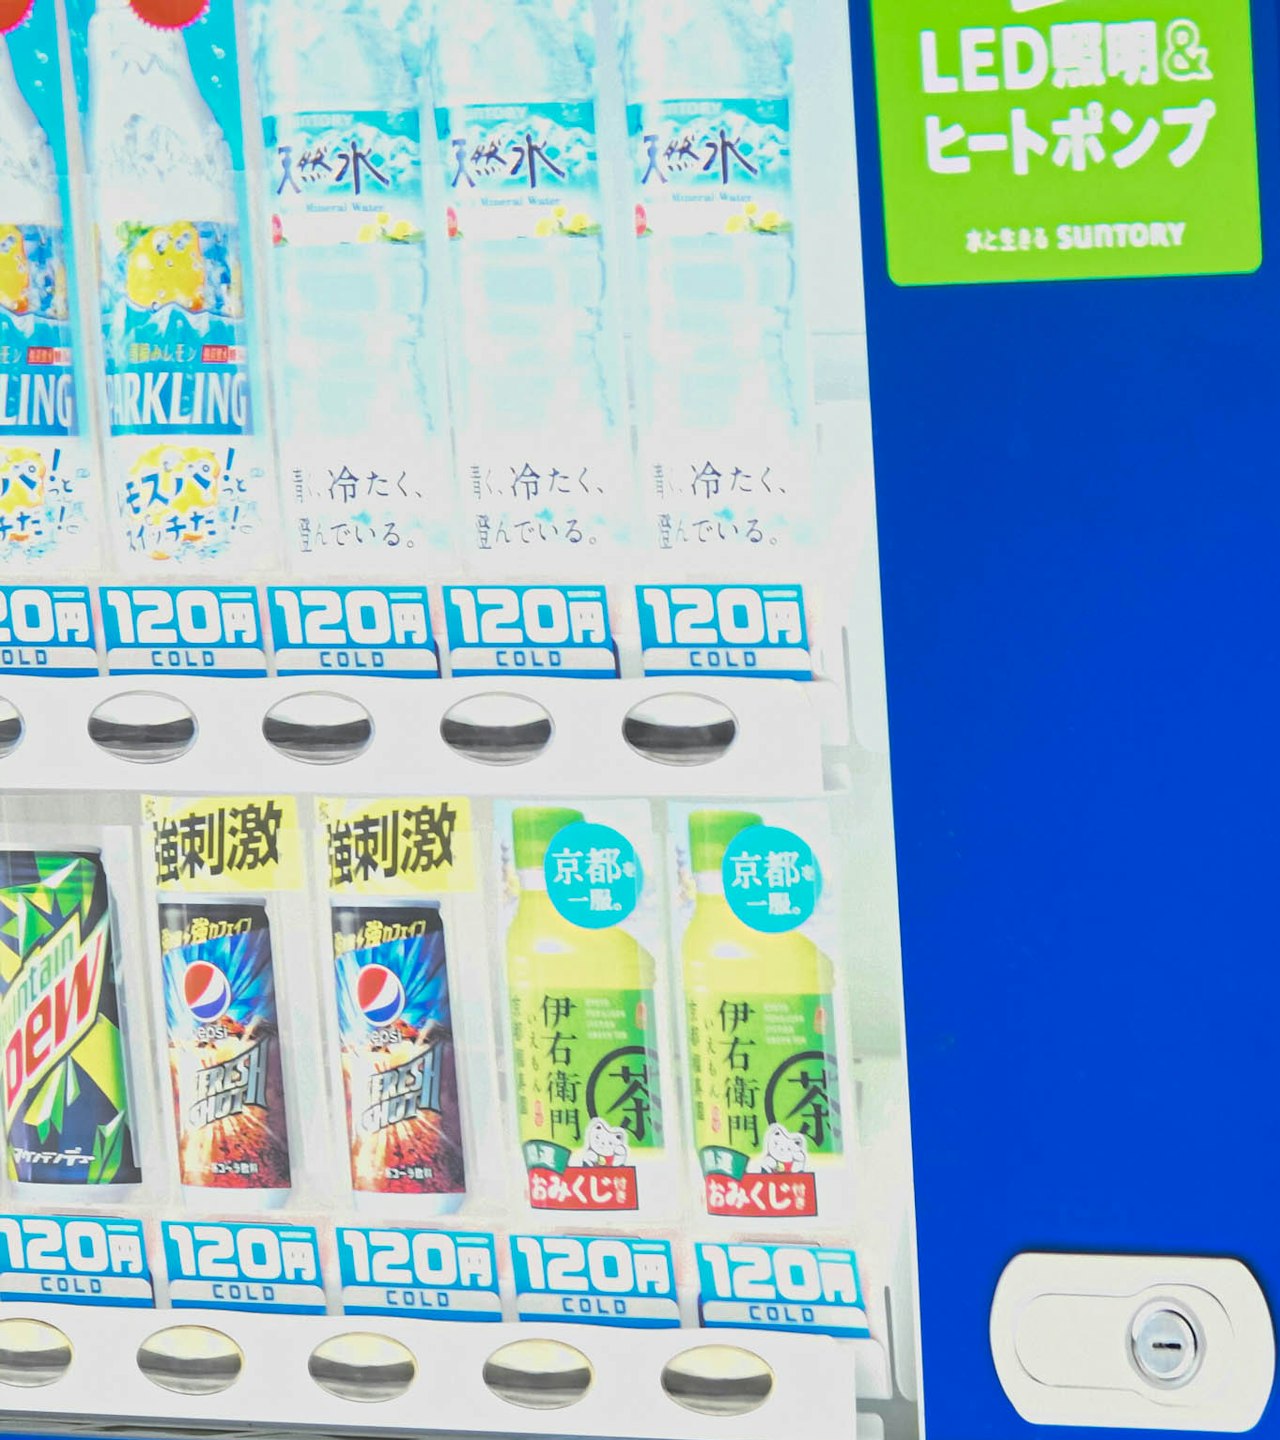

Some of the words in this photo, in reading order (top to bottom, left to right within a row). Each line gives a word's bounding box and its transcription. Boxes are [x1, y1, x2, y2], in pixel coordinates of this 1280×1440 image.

[451, 133, 566, 188] 天然水
[641, 129, 758, 185] 天然水
[923, 99, 1216, 175] ヒートポンプ
[277, 141, 390, 195] 天然水
[965, 226, 1049, 253] 水と生きる
[1056, 221, 1187, 249] SUNTORY
[106, 588, 259, 644] 120円
[274, 588, 428, 645] 120円
[449, 587, 606, 645] 120円
[642, 587, 803, 645] 120円
[150, 649, 215, 667] COLD
[320, 650, 385, 668] COLD
[495, 649, 562, 667] COLD
[690, 649, 758, 667] COLD
[153, 800, 284, 887] 強刺激
[326, 801, 457, 888] 強刺激
[194, 1025, 229, 1041] epsi
[368, 1028, 403, 1044] epsi
[541, 995, 582, 1142] 伊右衛門
[719, 999, 760, 1148] 伊右衛門
[169, 1224, 316, 1281] 120円
[343, 1230, 494, 1287] 120円
[517, 1237, 671, 1294] 120円
[702, 1244, 859, 1302] 120円
[41, 1276, 102, 1294] COLD
[213, 1283, 275, 1301] COLD
[386, 1290, 449, 1307] COLD
[562, 1297, 627, 1315] COLD
[749, 1305, 815, 1323] COLD
